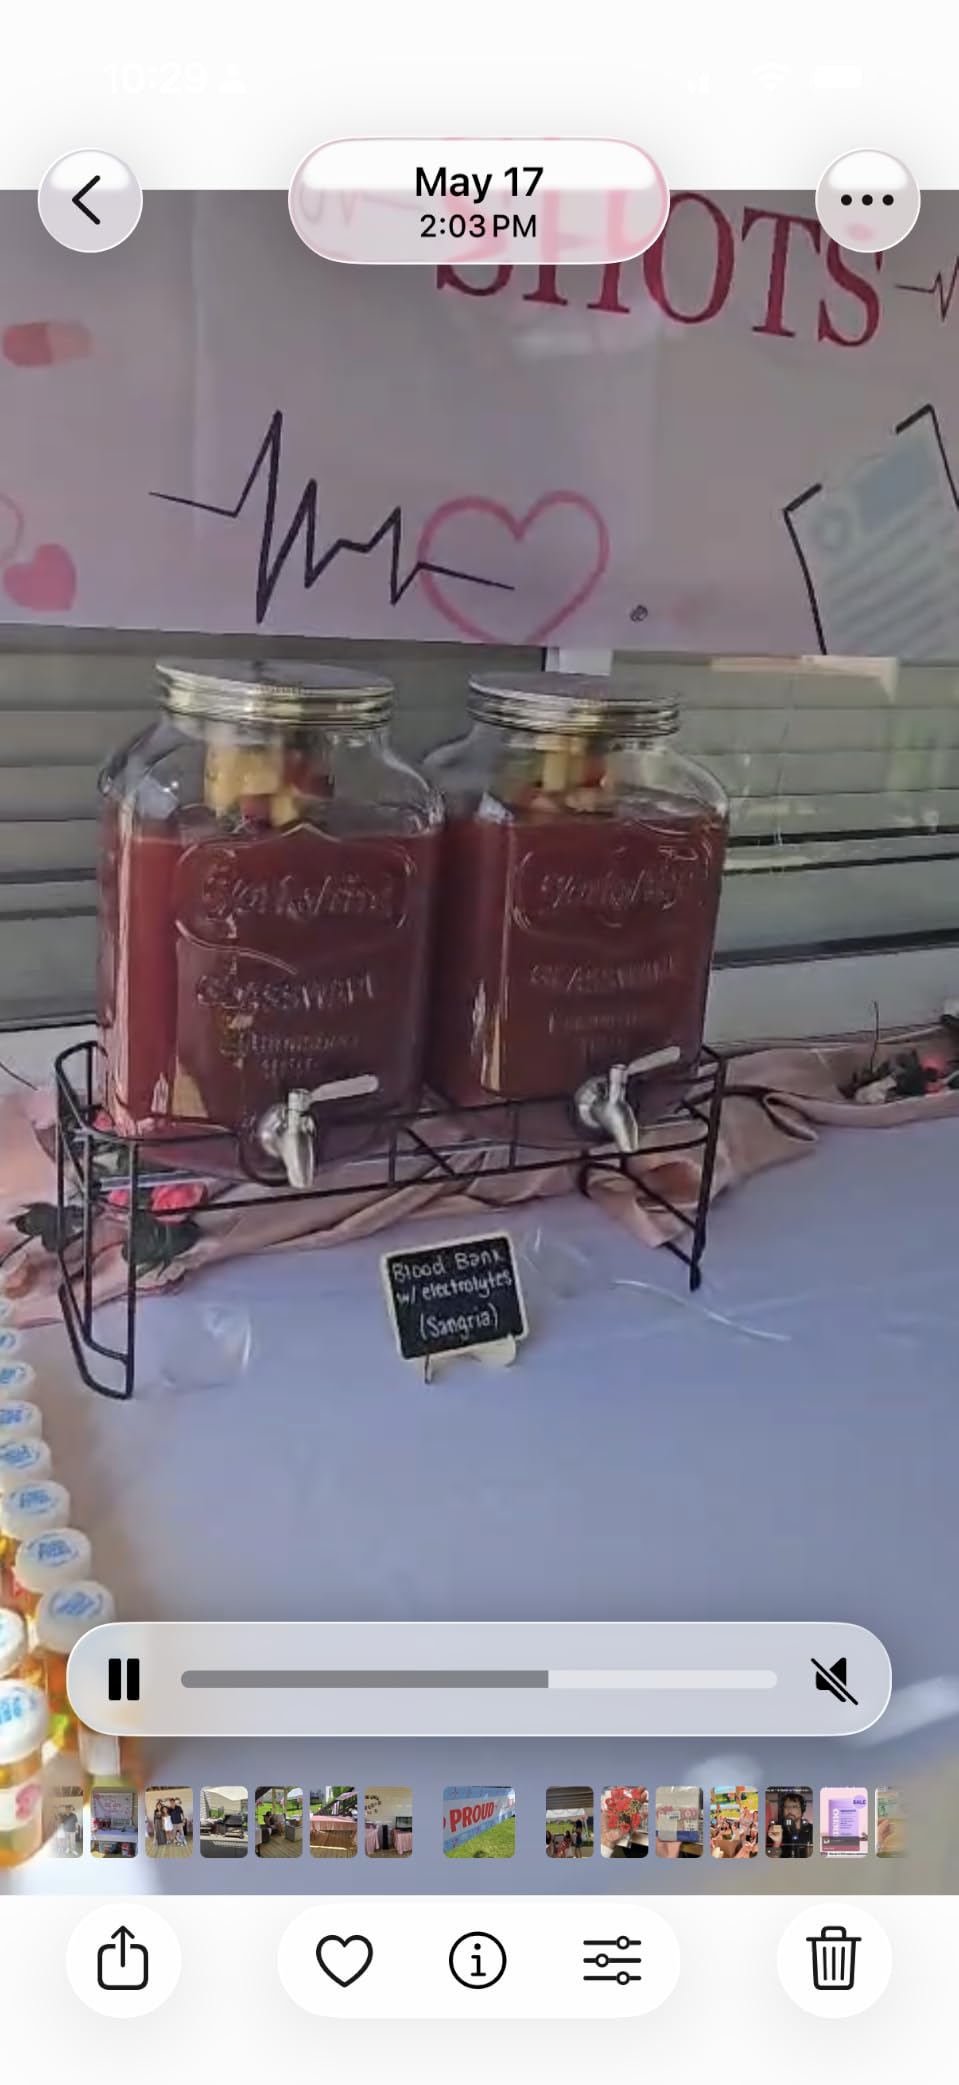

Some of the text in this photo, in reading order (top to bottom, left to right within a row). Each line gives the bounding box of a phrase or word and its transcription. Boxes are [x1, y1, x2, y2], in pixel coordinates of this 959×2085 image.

[436, 190, 883, 347] SHOTS
[392, 1250, 505, 1283] Blood Bank
[396, 1269, 512, 1304] w/ electrolytes
[420, 1303, 498, 1340] (Sangria)
[449, 1801, 495, 1833] PROUD
